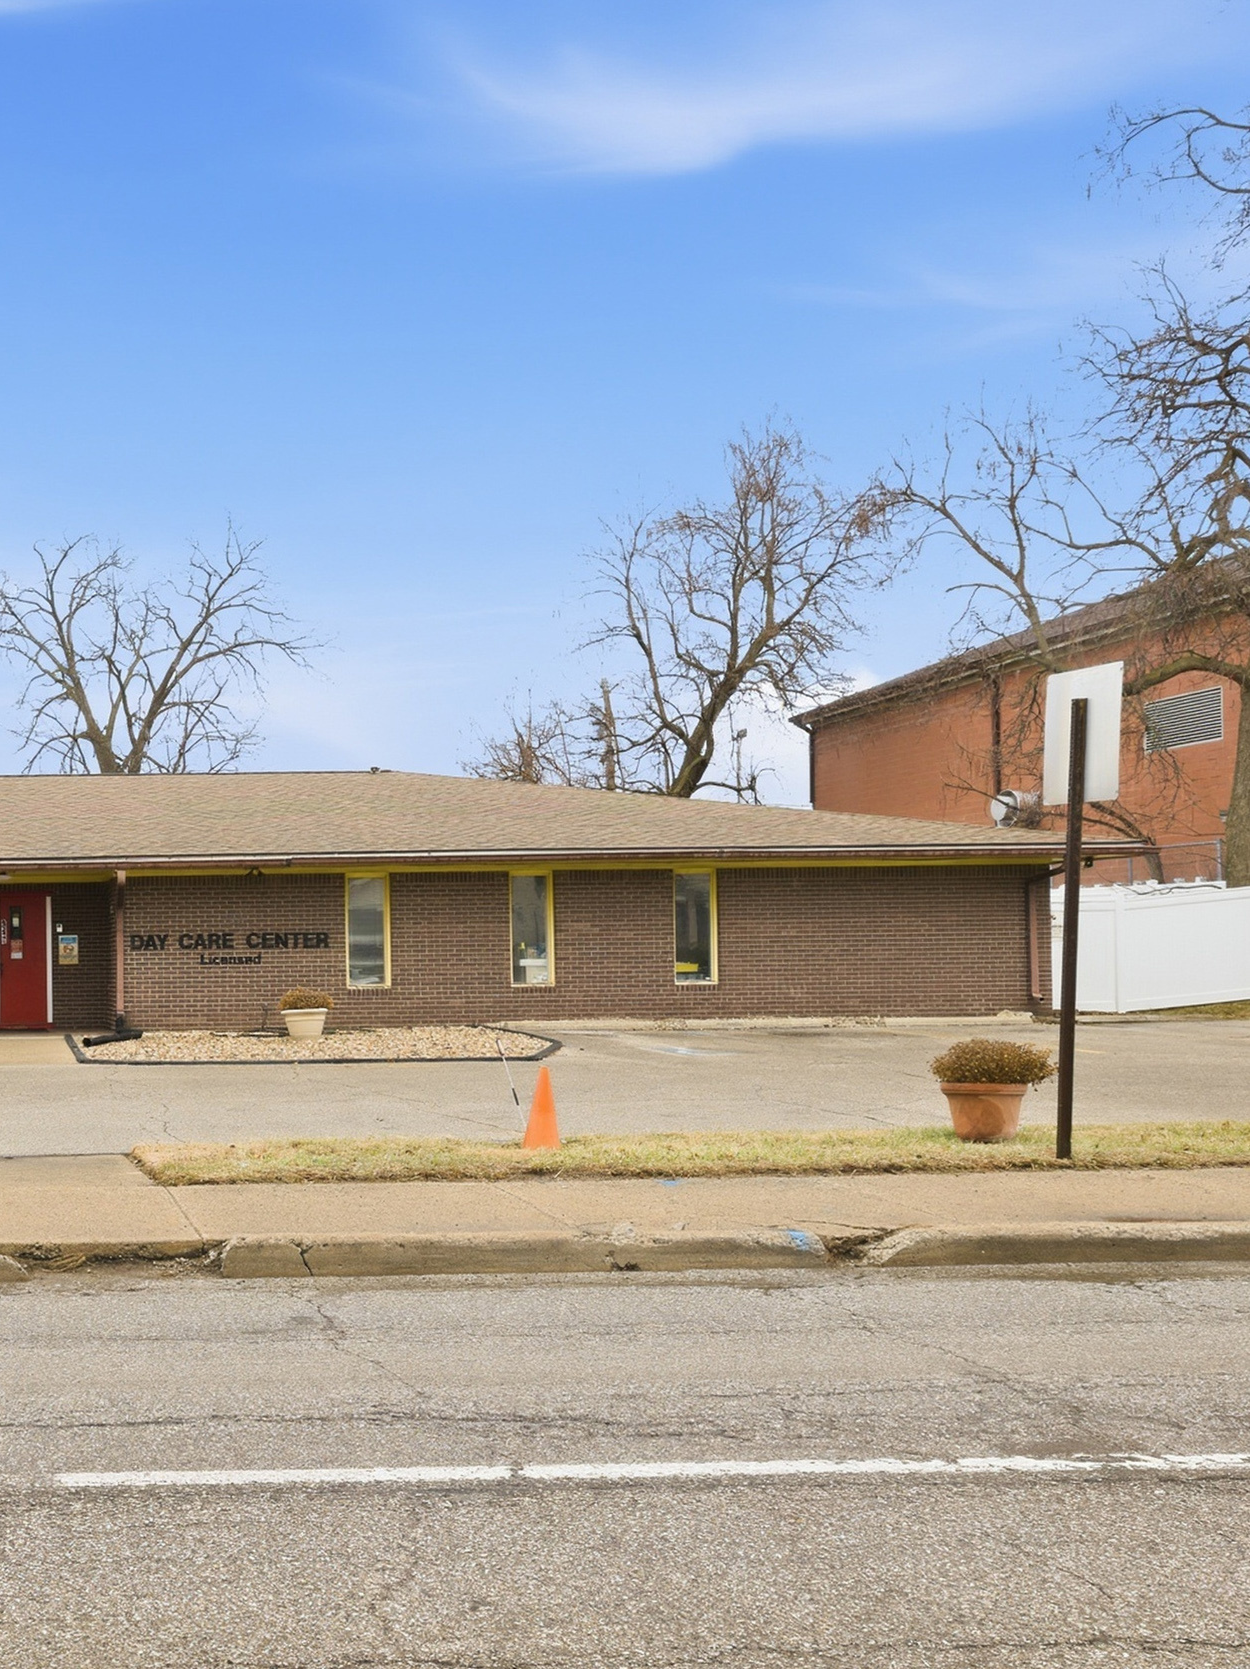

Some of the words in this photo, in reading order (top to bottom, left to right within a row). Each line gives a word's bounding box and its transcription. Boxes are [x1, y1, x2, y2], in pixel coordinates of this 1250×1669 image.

[130, 933, 168, 950] DAY
[178, 932, 235, 950] CARE
[246, 931, 330, 949] CENTER
[200, 952, 262, 966] Licensed
